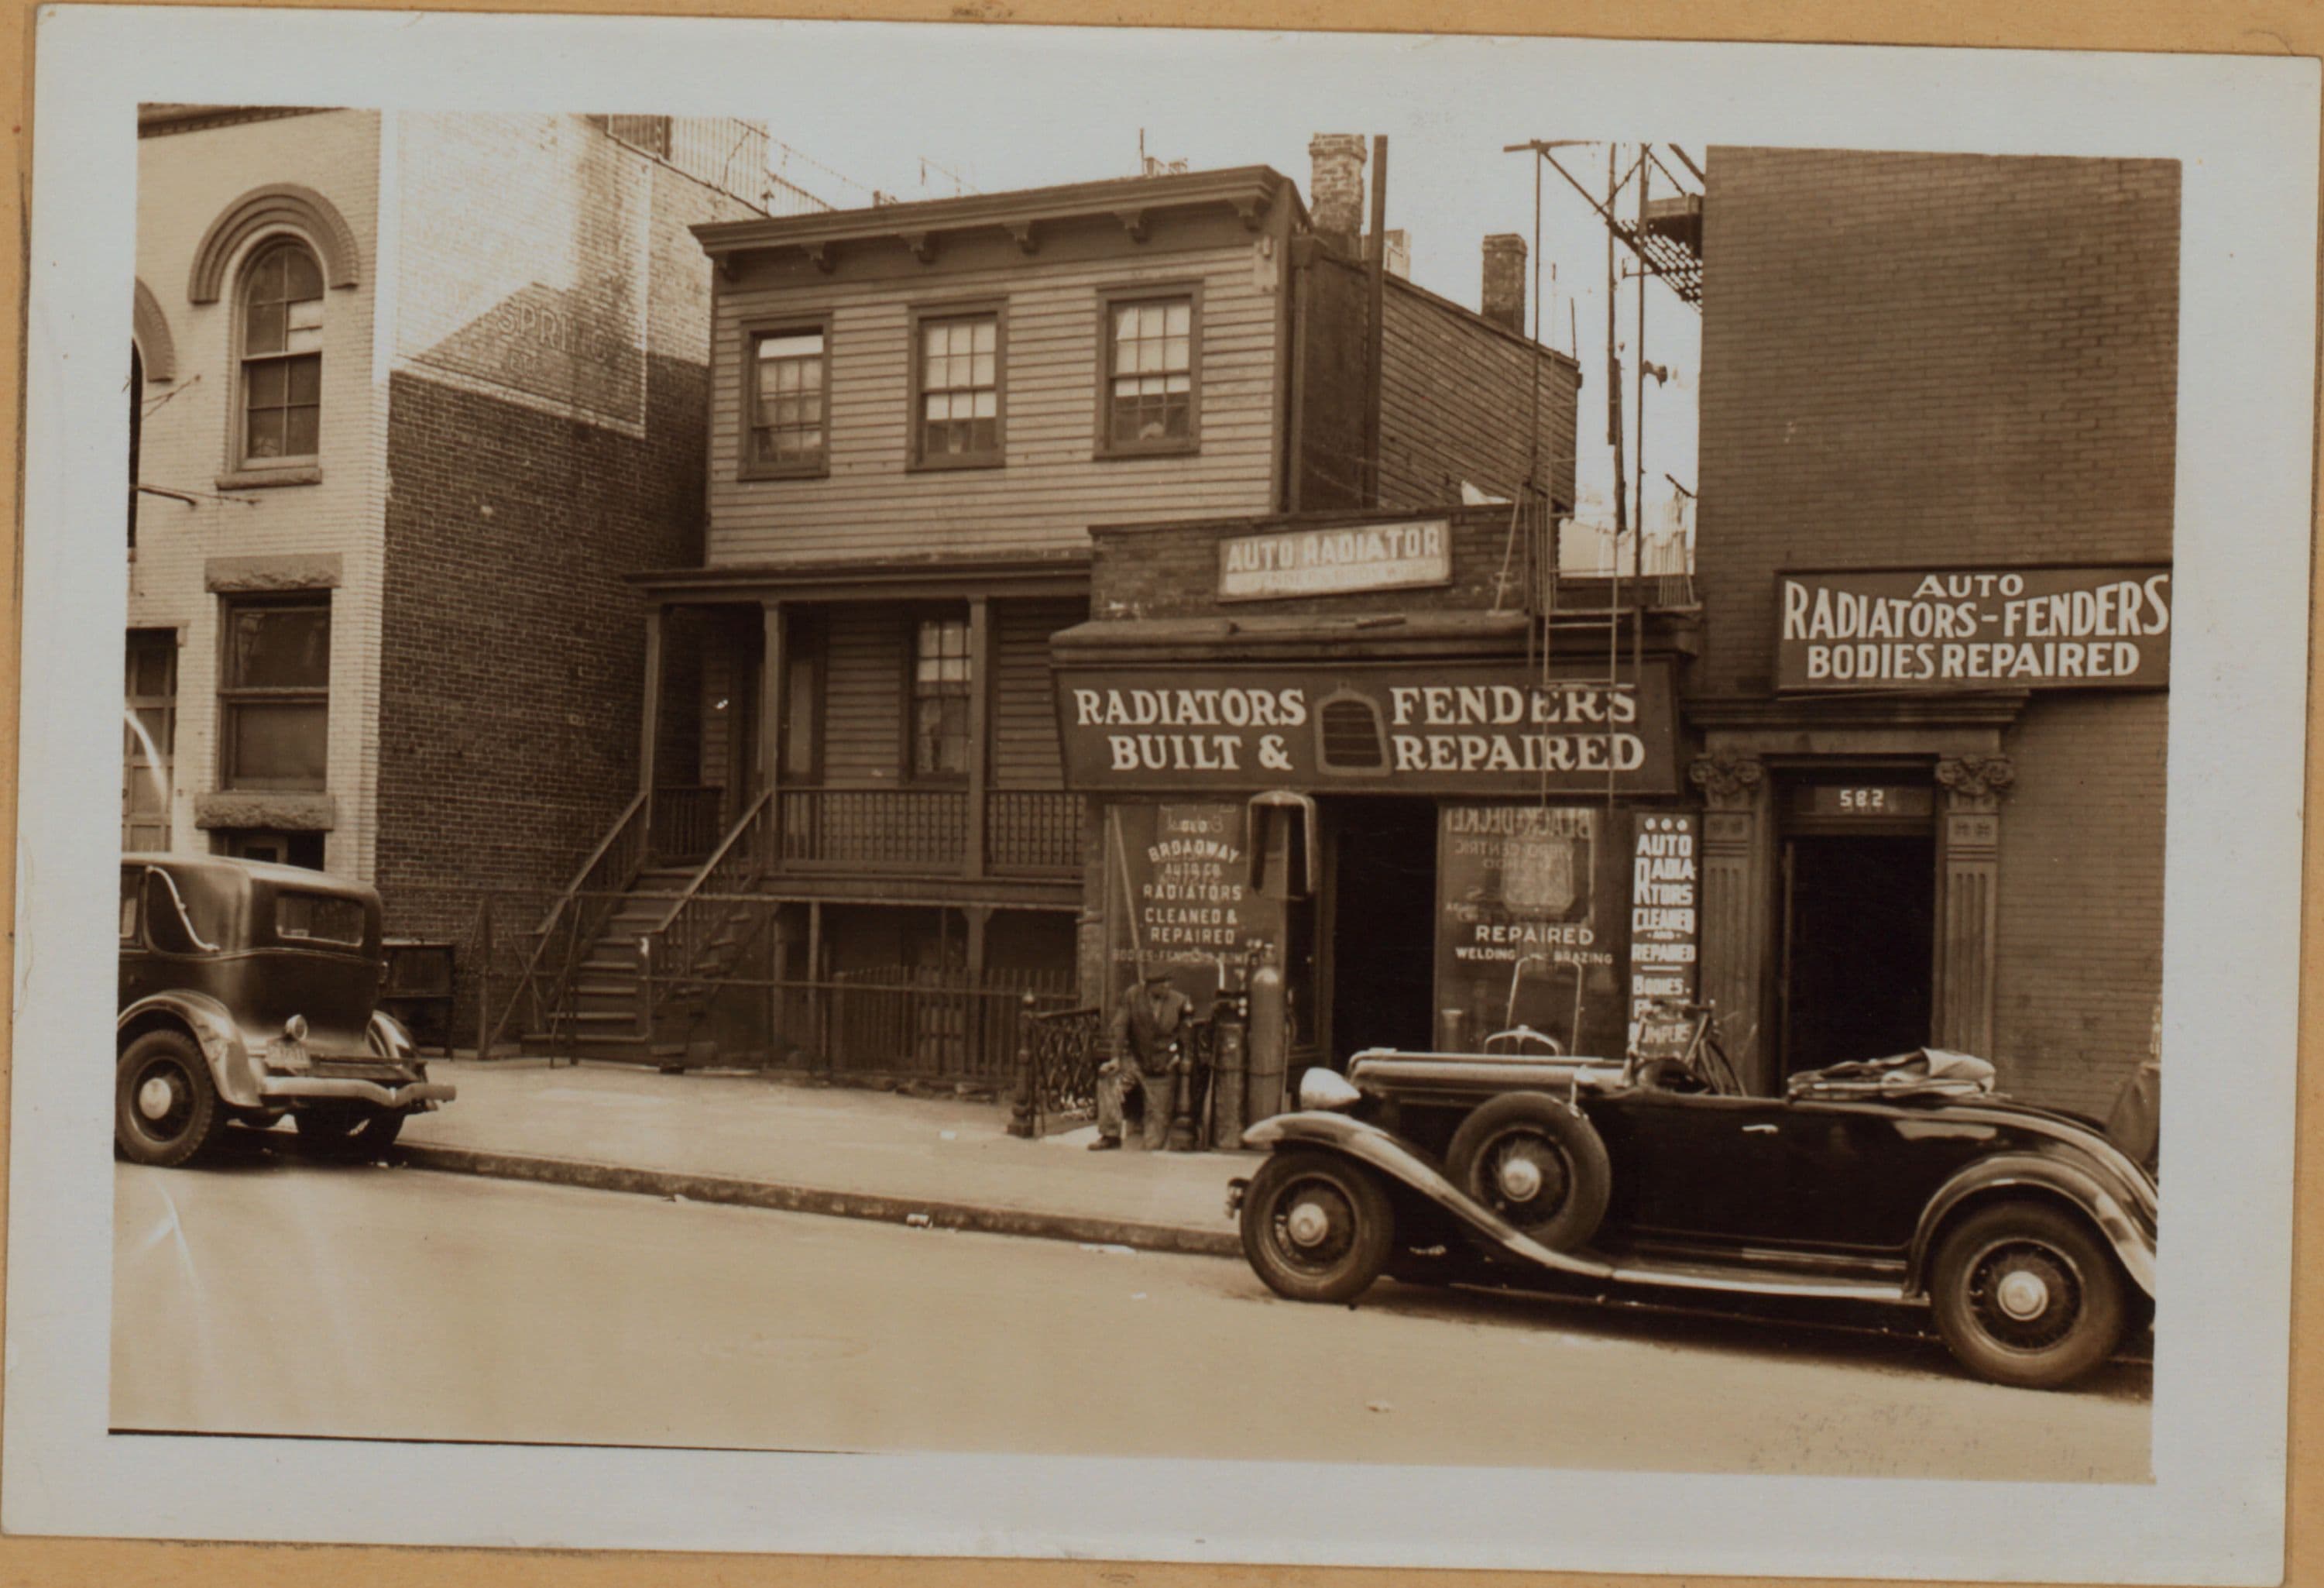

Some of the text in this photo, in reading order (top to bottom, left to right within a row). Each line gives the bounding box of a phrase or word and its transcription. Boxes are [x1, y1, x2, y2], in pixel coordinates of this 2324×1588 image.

[498, 301, 608, 364] SPRIG
[1227, 524, 1440, 572] AUTO RADIATOR
[1913, 573, 2024, 599] AUTO
[1807, 641, 2140, 679] BODIES REPAIRED
[1073, 684, 1636, 727] RADIATORS FENDERS
[1109, 731, 1646, 772] BUILT & REPAIRED
[1840, 788, 1885, 807] 582
[1148, 840, 1240, 863] BROADWAY
[1636, 834, 1692, 858] AUTO
[1143, 885, 1242, 901] RADIATORS
[1145, 908, 1238, 924] CLEANED &
[1632, 907, 1695, 934] CLEANED
[1151, 927, 1235, 945] REPAIRED
[1475, 925, 1595, 945] REPAIRED
[1456, 947, 1613, 964] WELDING BRAZING
